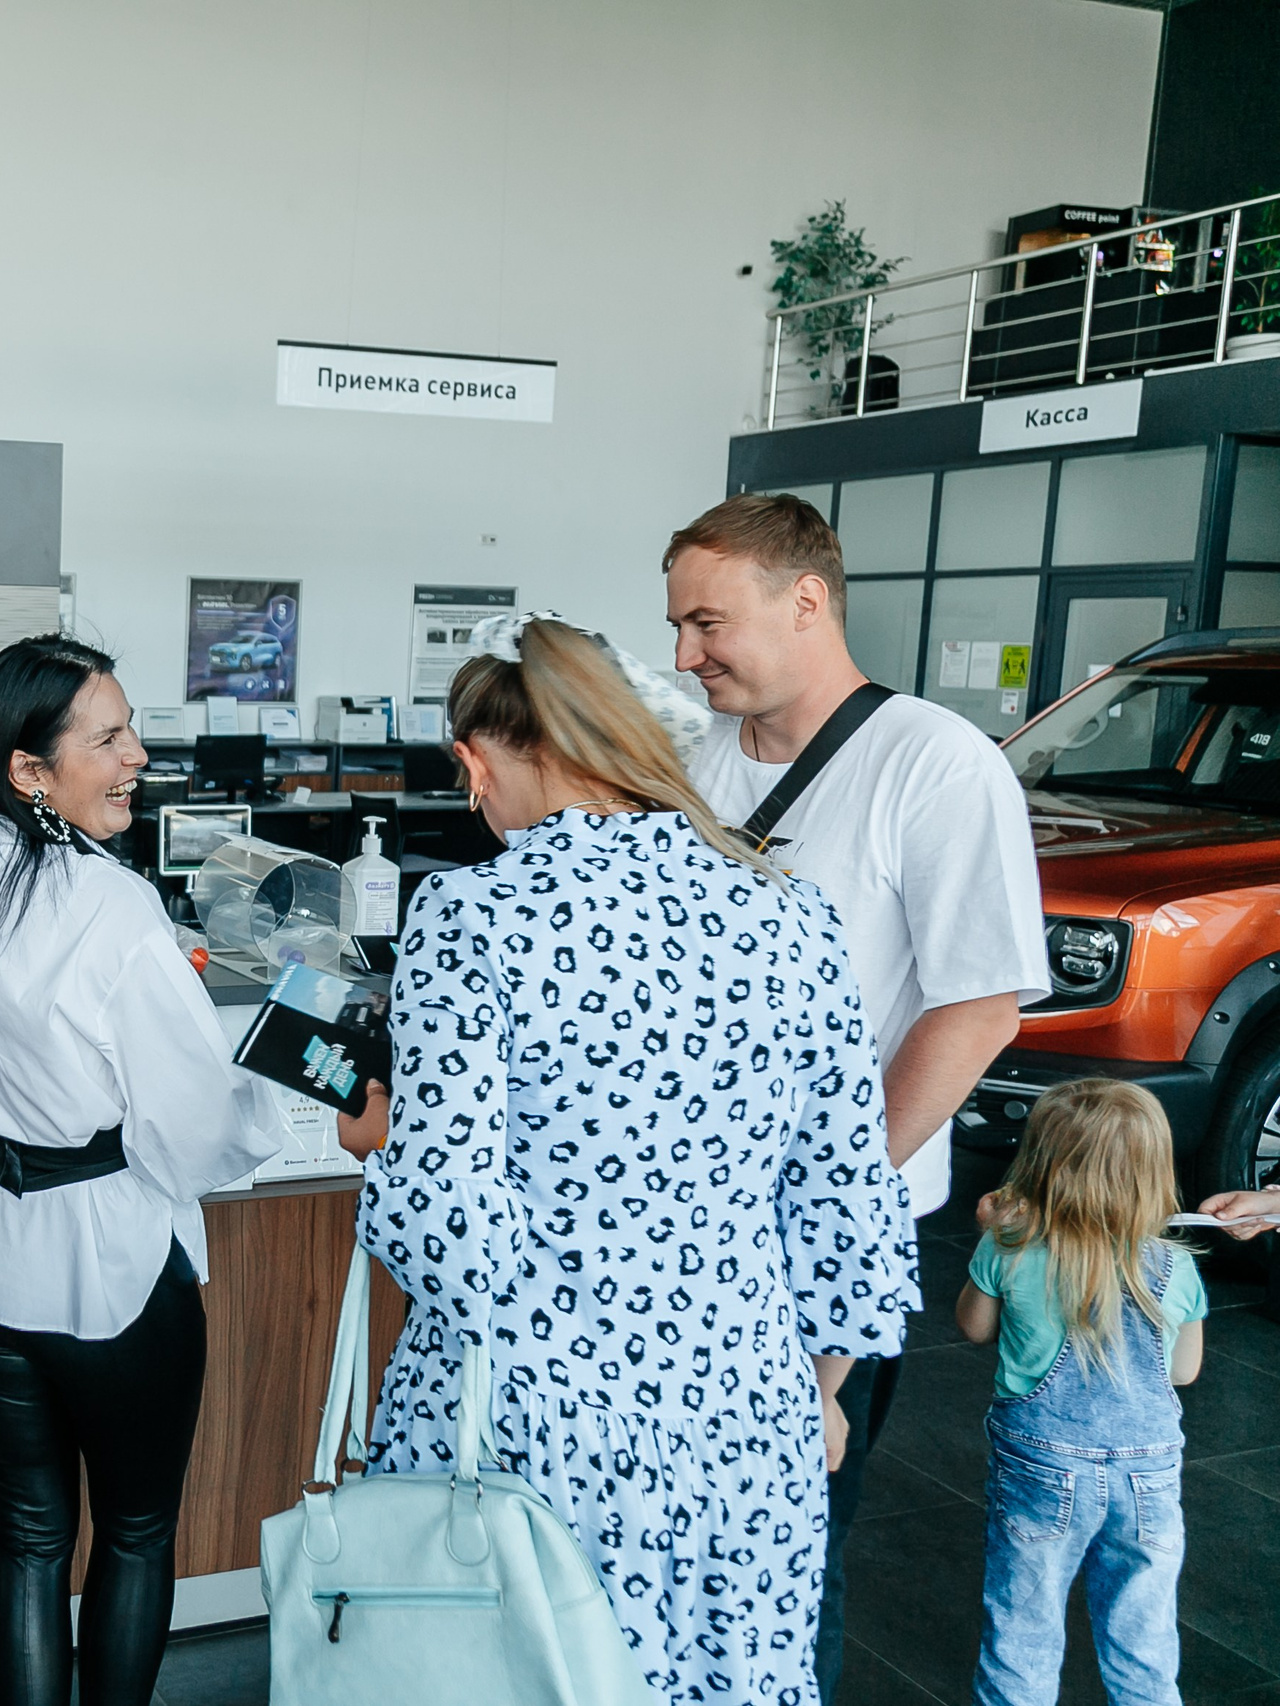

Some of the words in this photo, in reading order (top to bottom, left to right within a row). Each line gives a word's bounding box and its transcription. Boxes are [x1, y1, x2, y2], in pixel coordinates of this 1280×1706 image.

[1064, 209, 1097, 222] COFFEE
[317, 366, 420, 394] Приемка
[428, 378, 517, 401] сервиса
[1025, 406, 1089, 429] Касса
[1249, 732, 1271, 746] 418
[302, 1043, 331, 1079] ВАЖЕН
[313, 1043, 347, 1090] КАЖДЫЙ
[331, 1059, 355, 1088] ДЕНЬ
